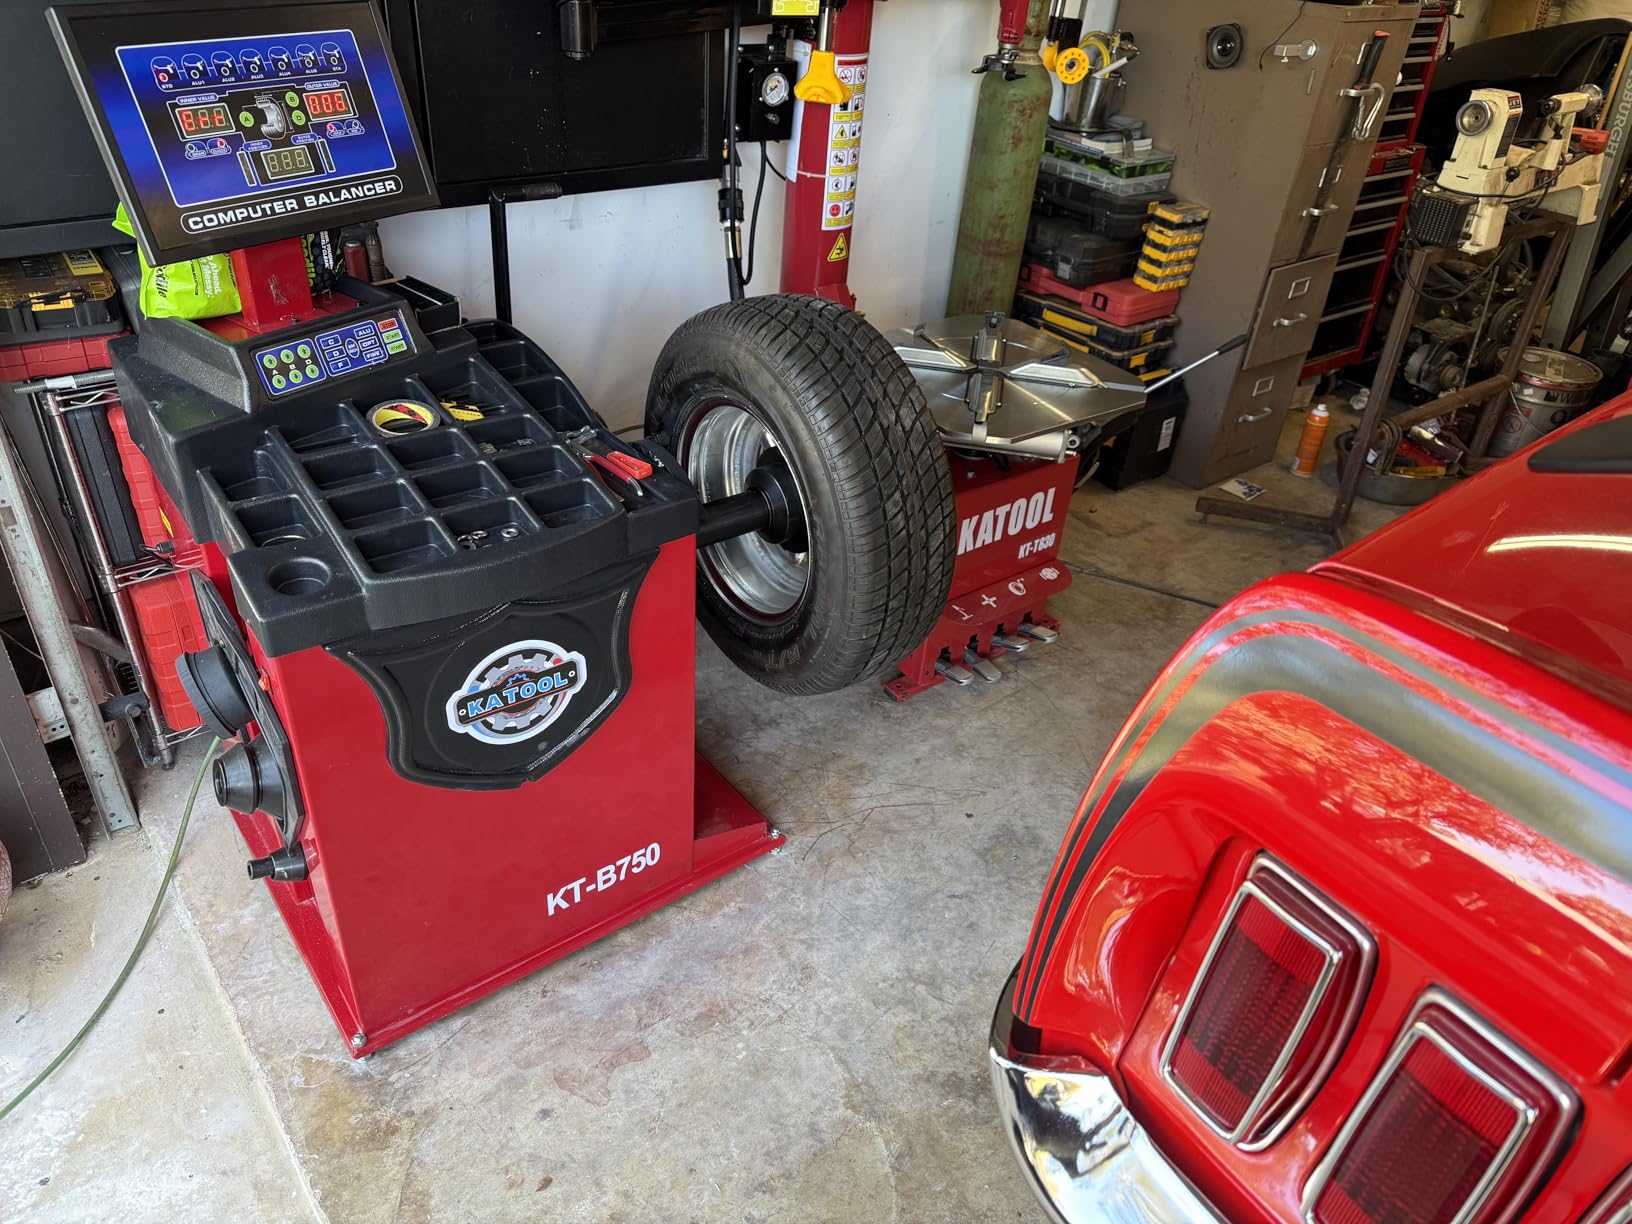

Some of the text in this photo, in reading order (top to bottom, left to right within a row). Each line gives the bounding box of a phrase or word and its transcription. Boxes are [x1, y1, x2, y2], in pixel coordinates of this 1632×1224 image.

[1605, 70, 1632, 158] SBURGH
[188, 180, 397, 230] COMPUTER BALANCER
[358, 328, 371, 336] ALU
[362, 339, 375, 347] OPT
[956, 486, 1057, 556] KATOOL
[466, 671, 569, 718] KATOOL
[546, 842, 661, 917] KT-B750
